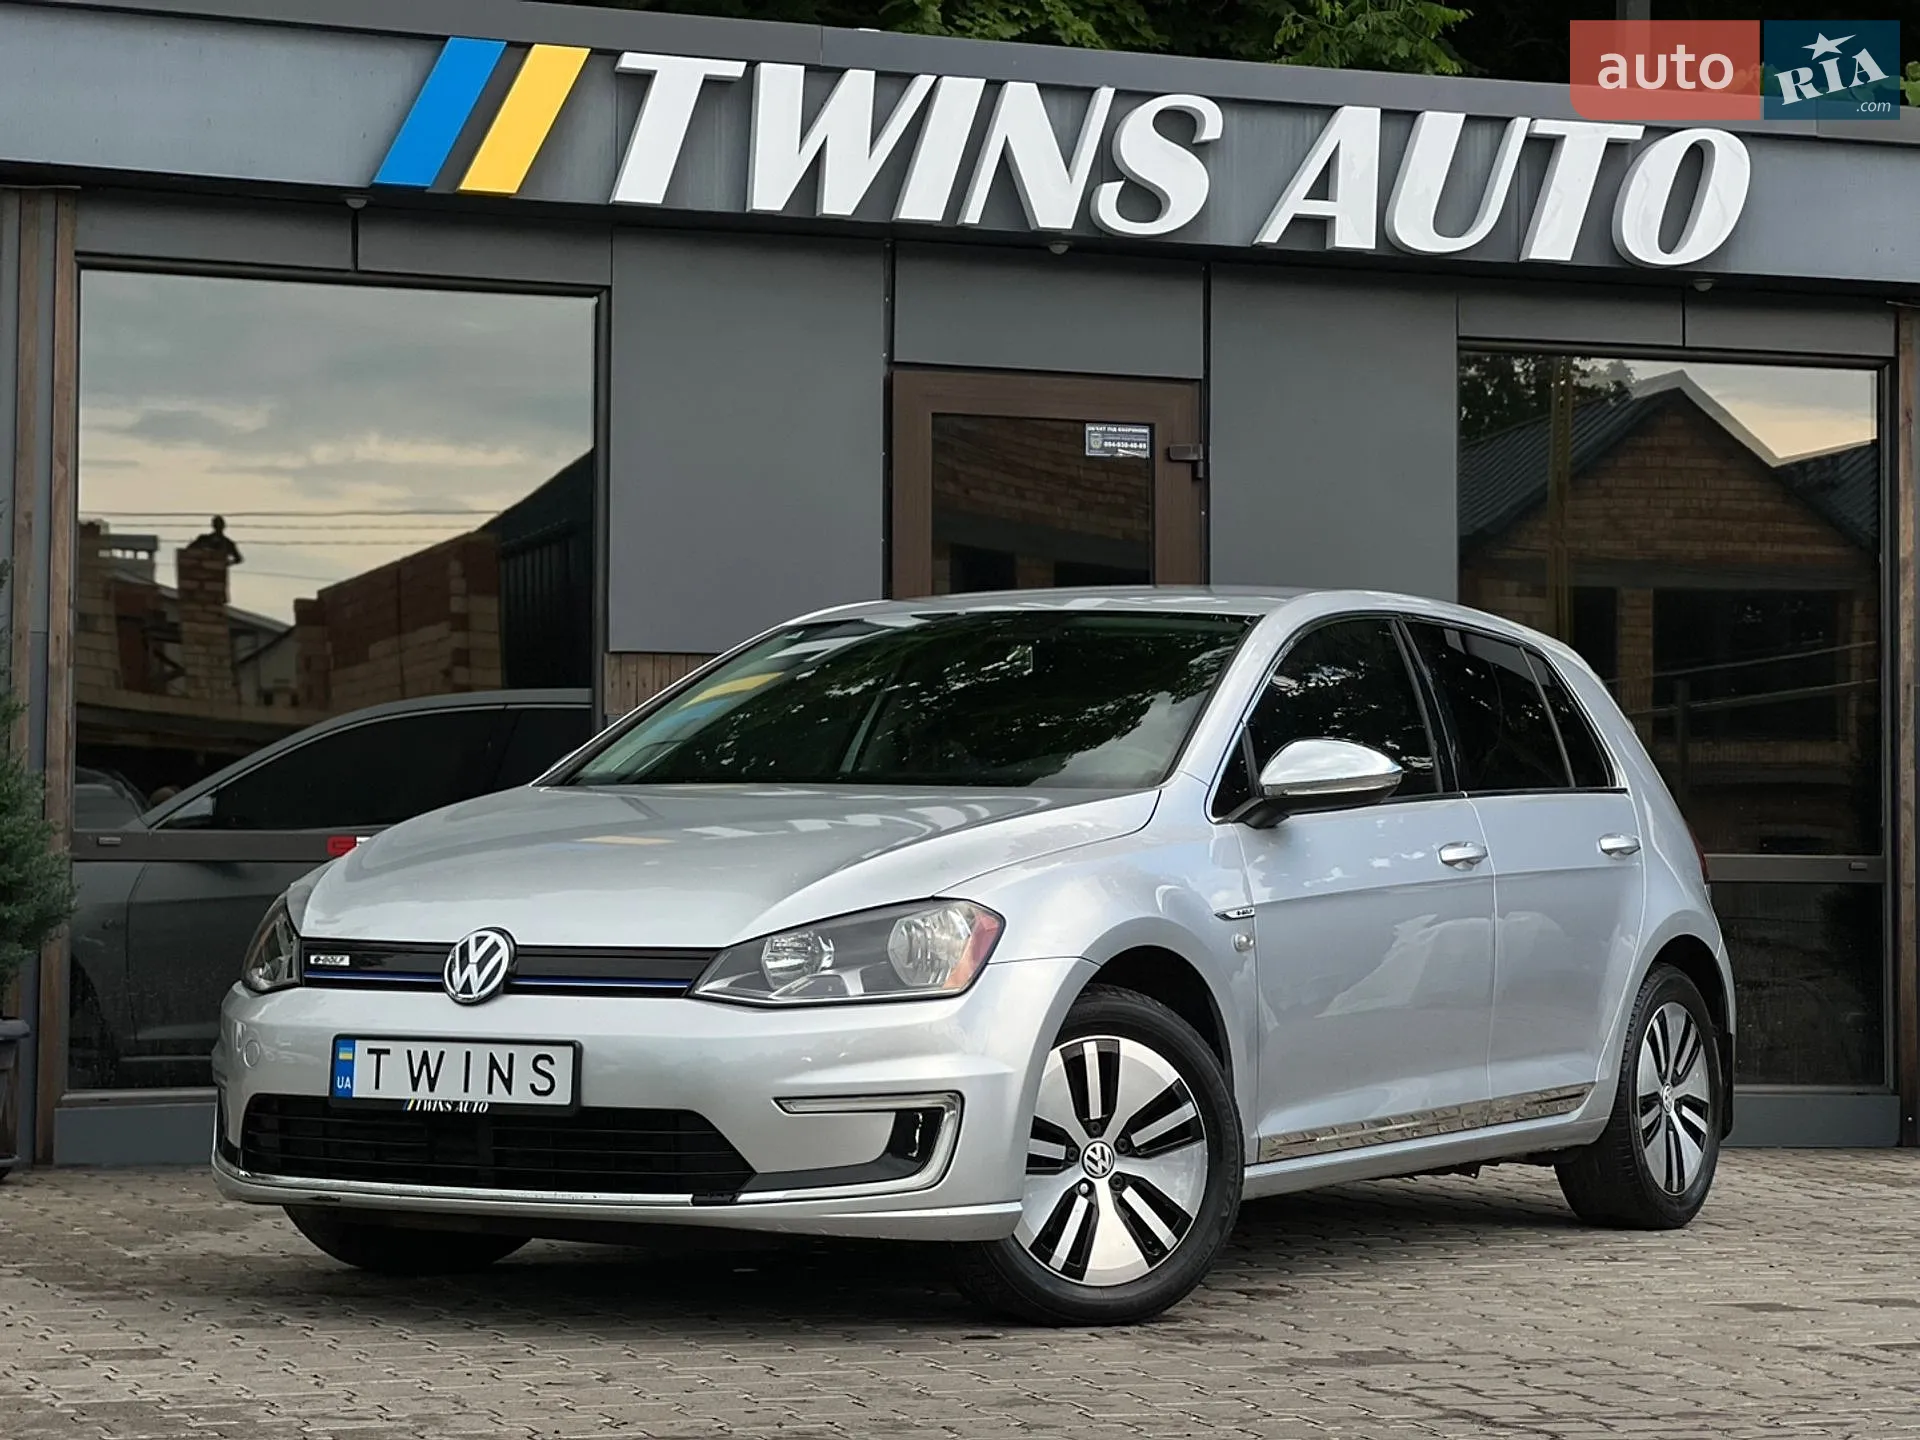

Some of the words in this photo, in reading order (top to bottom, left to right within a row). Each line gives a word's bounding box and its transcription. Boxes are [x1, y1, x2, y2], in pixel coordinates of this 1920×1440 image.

[610, 51, 1224, 238] TWINS
[1251, 104, 1752, 268] AUTO
[337, 1076, 352, 1089] UA
[367, 1047, 556, 1097] TWINS
[414, 1099, 452, 1112] TWINS
[454, 1100, 489, 1113] AUTO
